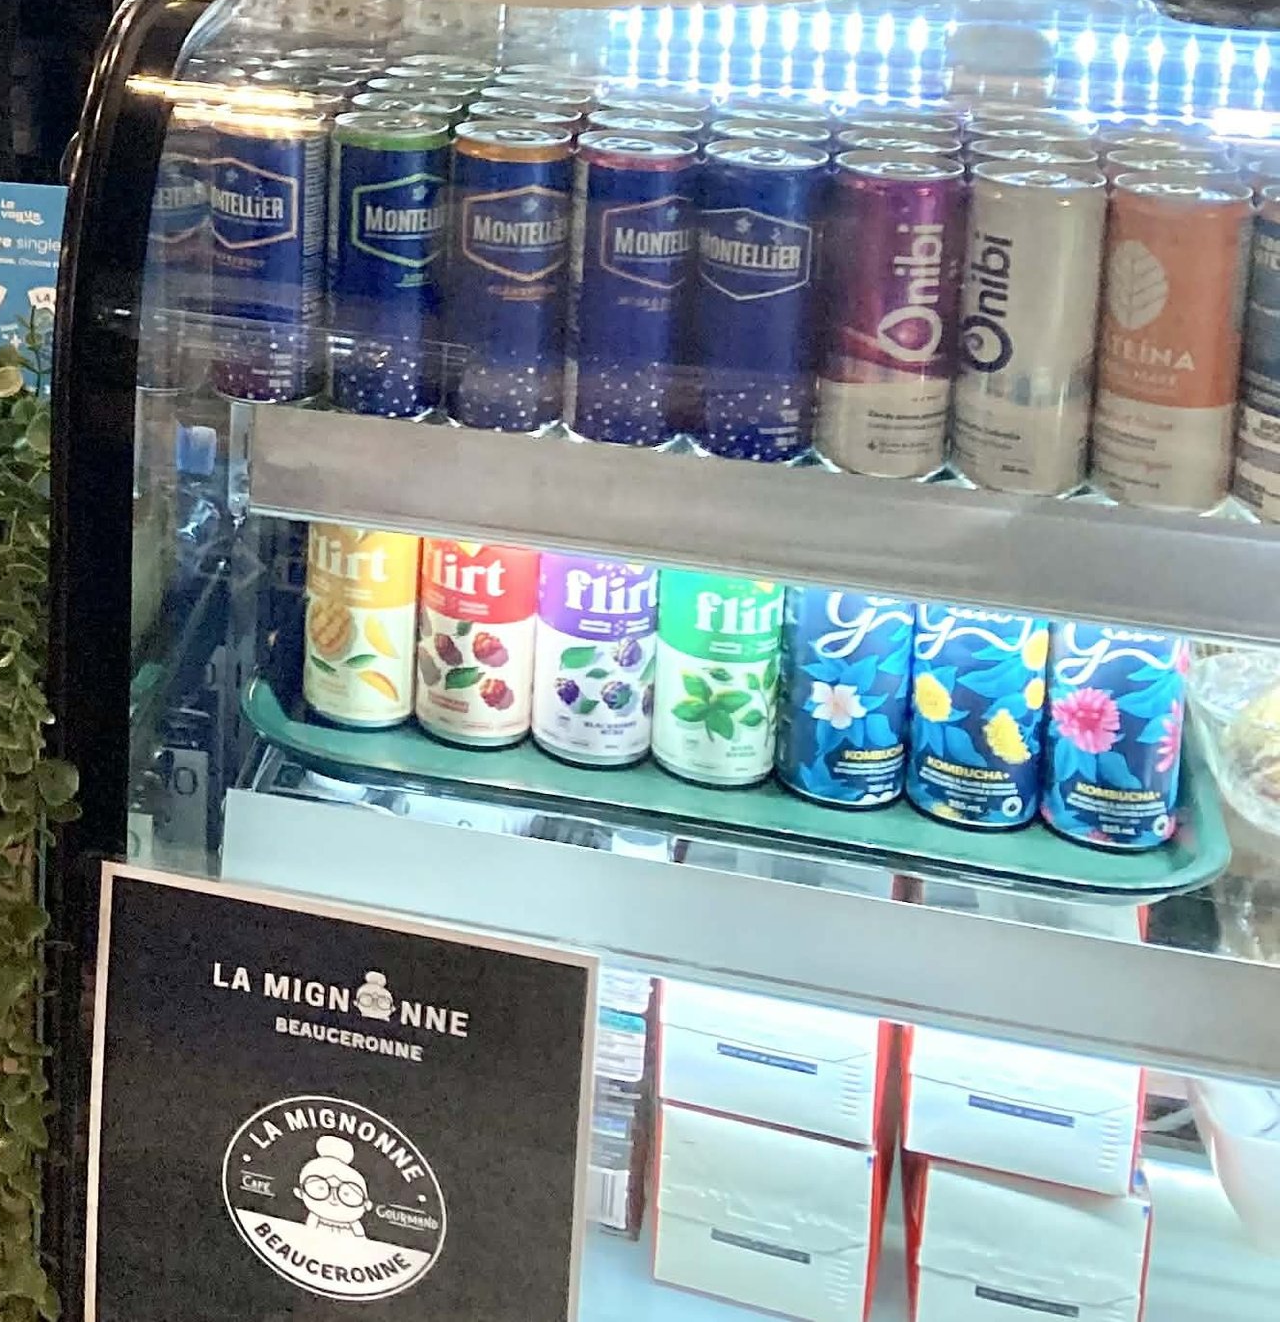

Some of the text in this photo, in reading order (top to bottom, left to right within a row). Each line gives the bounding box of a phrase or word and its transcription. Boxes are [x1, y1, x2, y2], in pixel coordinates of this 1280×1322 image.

[878, 224, 945, 362] Onibi
[213, 962, 251, 993] LA
[275, 1016, 424, 1062] BEAUCERONNE
[249, 1107, 426, 1184] LA MIGNONNE
[254, 1222, 412, 1284] BEAUCERONNE
